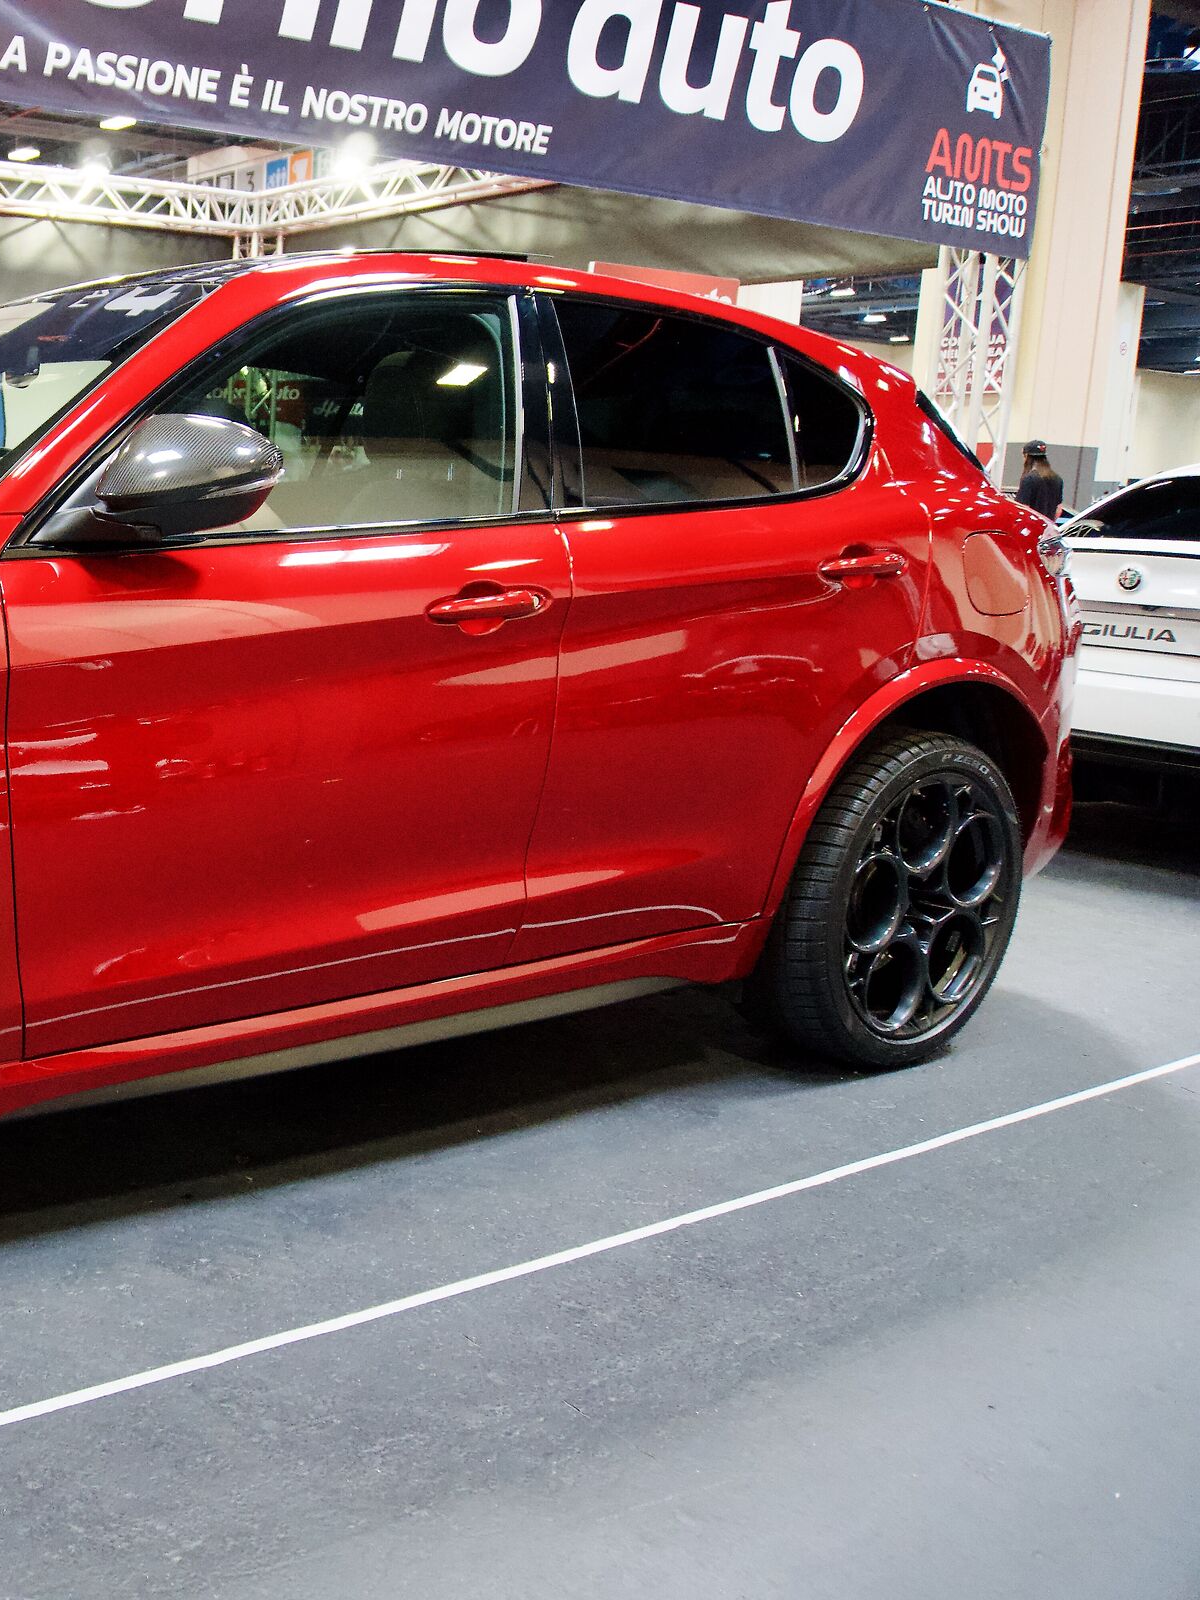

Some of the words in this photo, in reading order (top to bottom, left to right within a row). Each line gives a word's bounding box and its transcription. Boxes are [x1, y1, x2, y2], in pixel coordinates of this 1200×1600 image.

[43, 41, 222, 104] PASSIONE
[229, 63, 254, 108] È
[261, 78, 290, 115] IL
[301, 86, 429, 134] NOSTRO
[434, 108, 553, 156] MOTORE
[567, 0, 864, 143] auto
[925, 127, 1033, 193] AMTS
[921, 198, 975, 229] TURIN
[975, 210, 1027, 239] SHOW
[922, 175, 977, 206] AUTO
[978, 187, 1029, 217] MOTO
[1081, 622, 1177, 643] GIULIA
